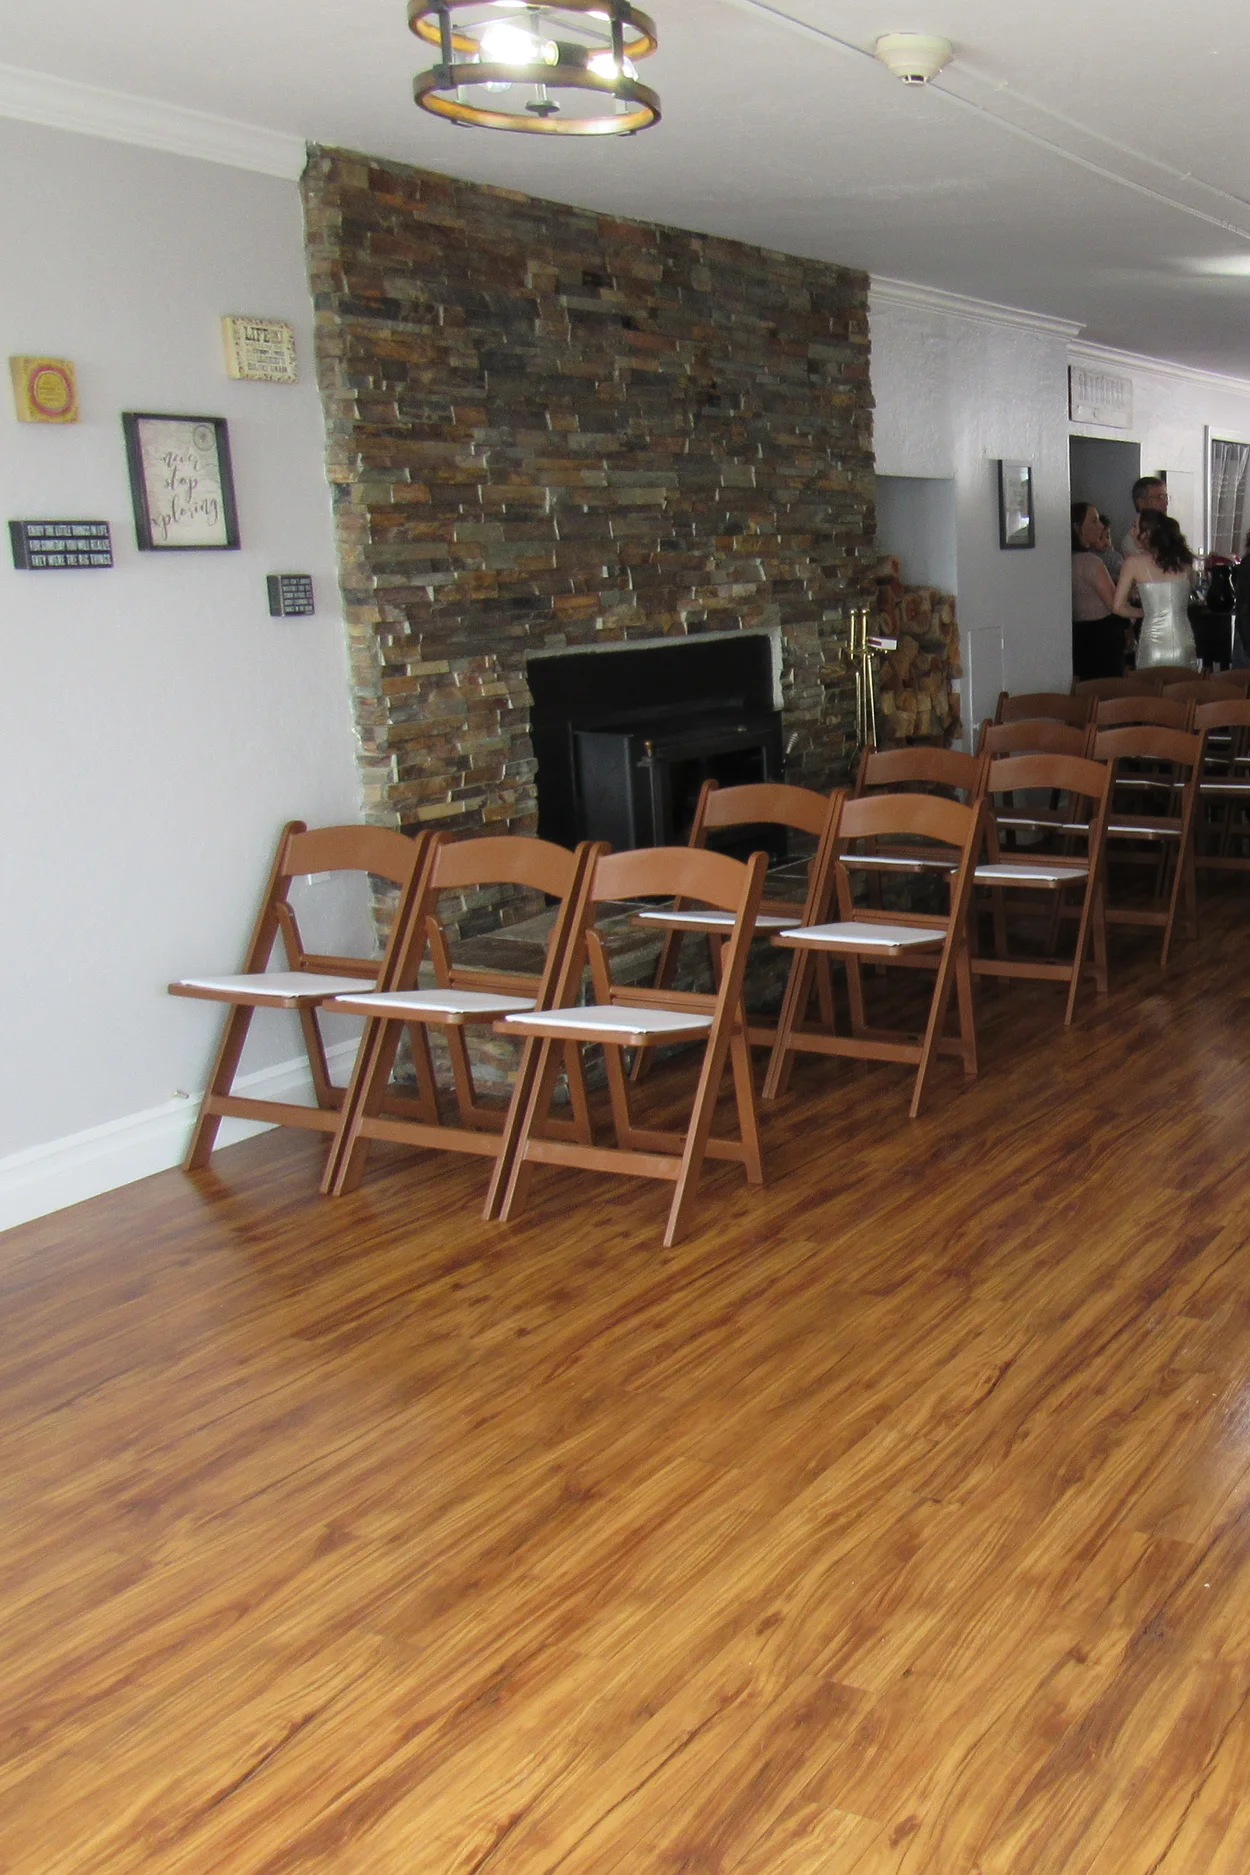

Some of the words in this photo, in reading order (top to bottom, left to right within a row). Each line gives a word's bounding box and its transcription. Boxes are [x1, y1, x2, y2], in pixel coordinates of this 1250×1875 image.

[243, 326, 270, 343] LIFE
[161, 451, 202, 473] never
[164, 466, 198, 504] stop
[151, 495, 218, 541] xploring
